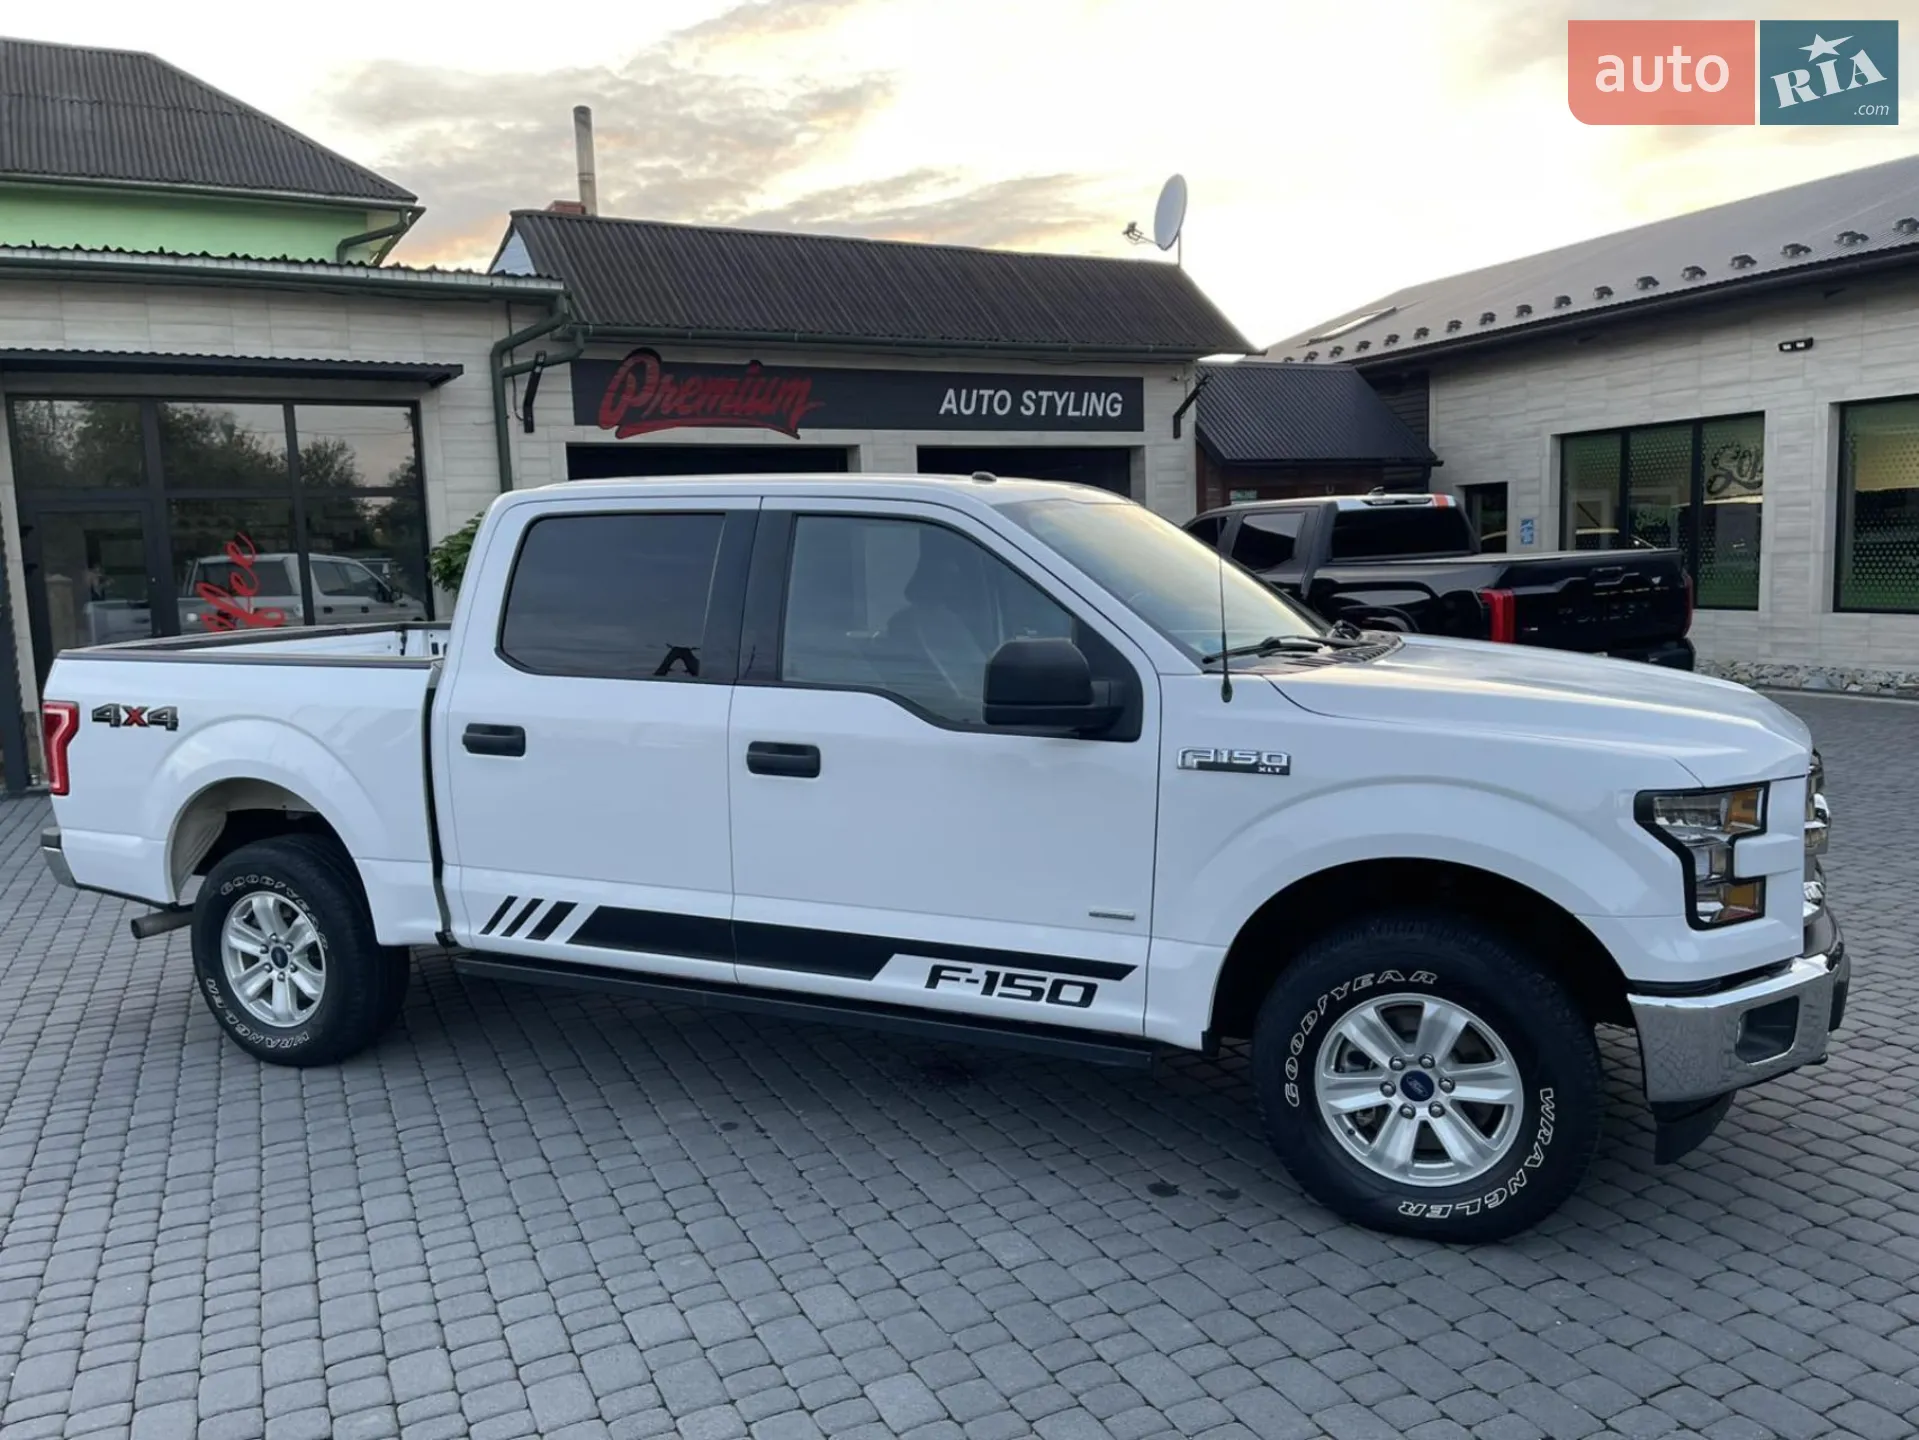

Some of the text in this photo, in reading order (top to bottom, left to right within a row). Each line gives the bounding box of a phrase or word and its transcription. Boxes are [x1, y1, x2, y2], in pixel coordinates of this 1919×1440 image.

[599, 348, 826, 438] Premium
[939, 388, 1123, 417] AUTO STYLING
[220, 874, 328, 949] GOODYEAR
[924, 964, 1098, 1008] F-150
[1285, 970, 1438, 1107] GOODYEAR
[1398, 1088, 1555, 1218] WRANGLER
